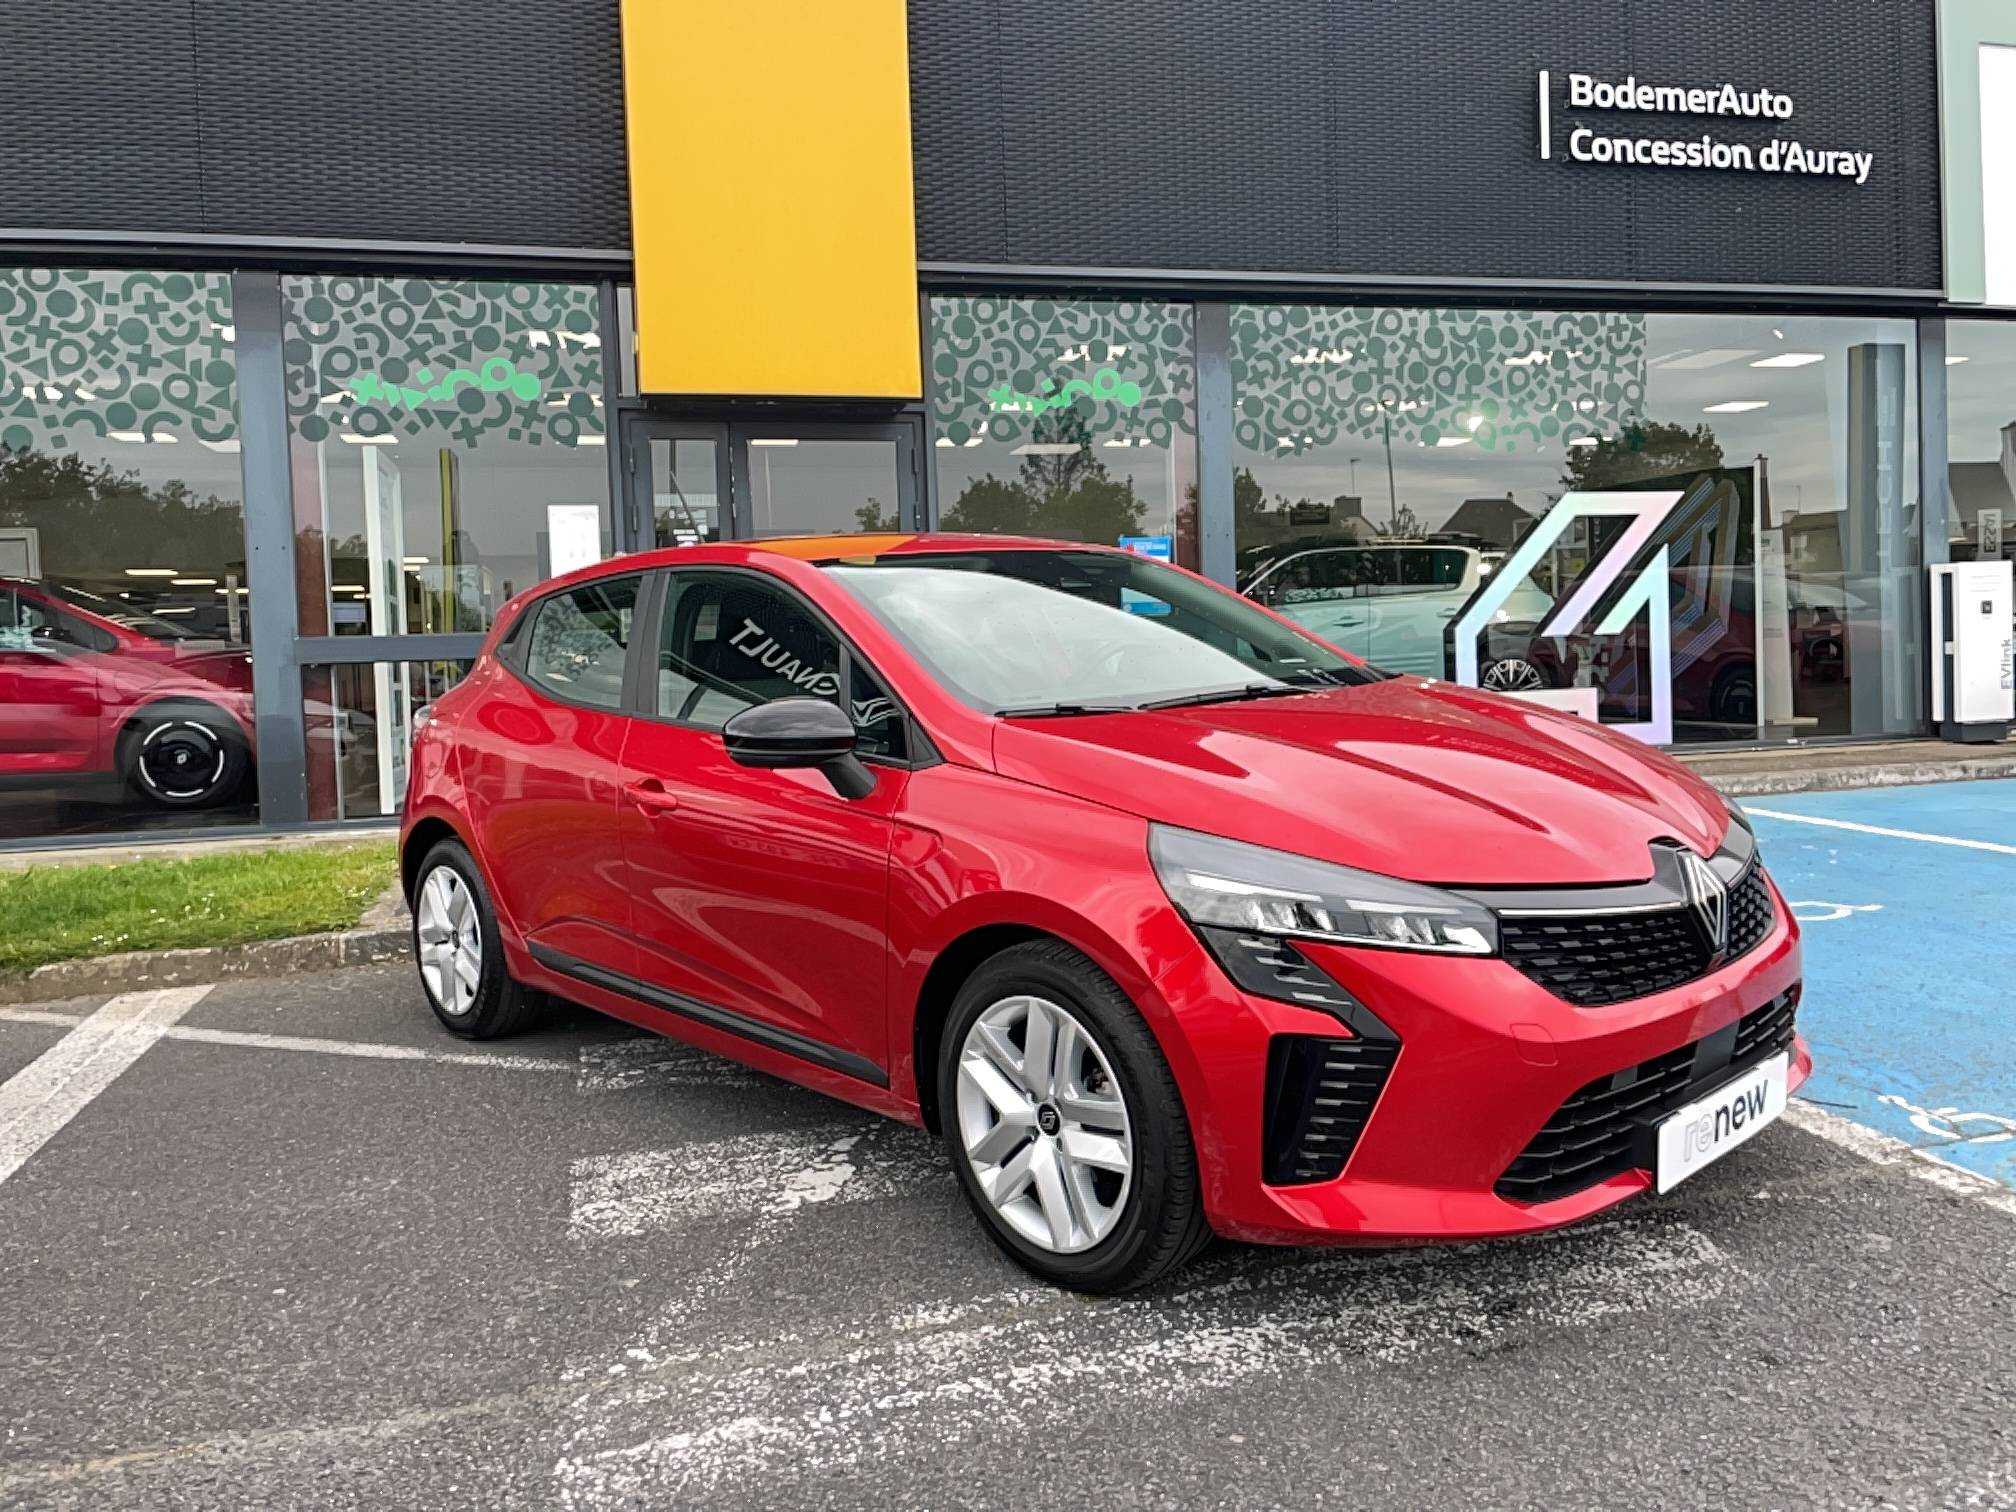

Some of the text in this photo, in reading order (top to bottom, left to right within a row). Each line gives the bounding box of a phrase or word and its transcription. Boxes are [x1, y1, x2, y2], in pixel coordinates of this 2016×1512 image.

[1568, 73, 1794, 119] BodemerAuto
[1569, 129, 1874, 185] Concession d'Auray
[1683, 1079, 1768, 1162] renew
